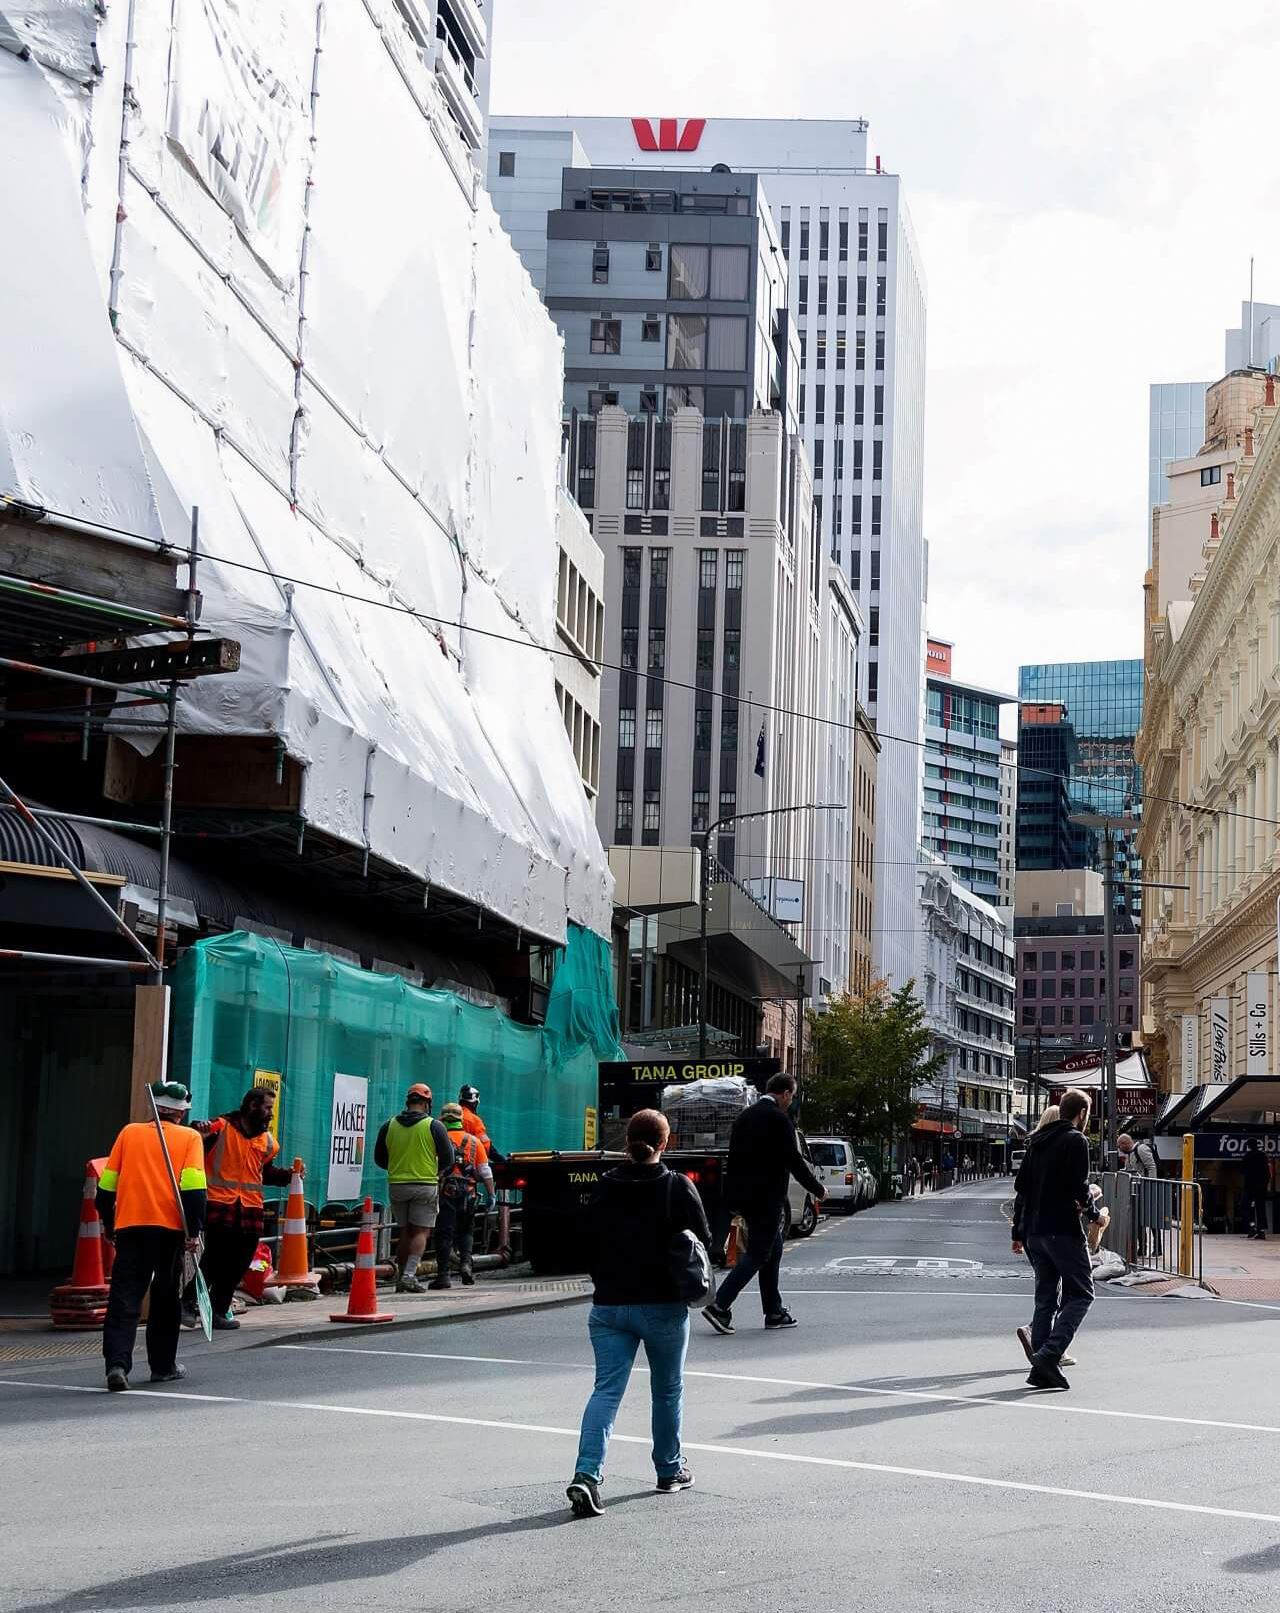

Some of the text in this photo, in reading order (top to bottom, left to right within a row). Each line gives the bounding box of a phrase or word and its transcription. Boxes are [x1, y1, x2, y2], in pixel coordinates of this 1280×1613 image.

[1249, 1003, 1266, 1018] Co
[1249, 1032, 1266, 1057] Sills
[632, 1063, 745, 1080] TANA GROUP
[1065, 1060, 1088, 1070] OLD
[333, 1101, 366, 1132] McKEE
[331, 1135, 355, 1165] FEHL
[568, 1172, 598, 1183] TANA
